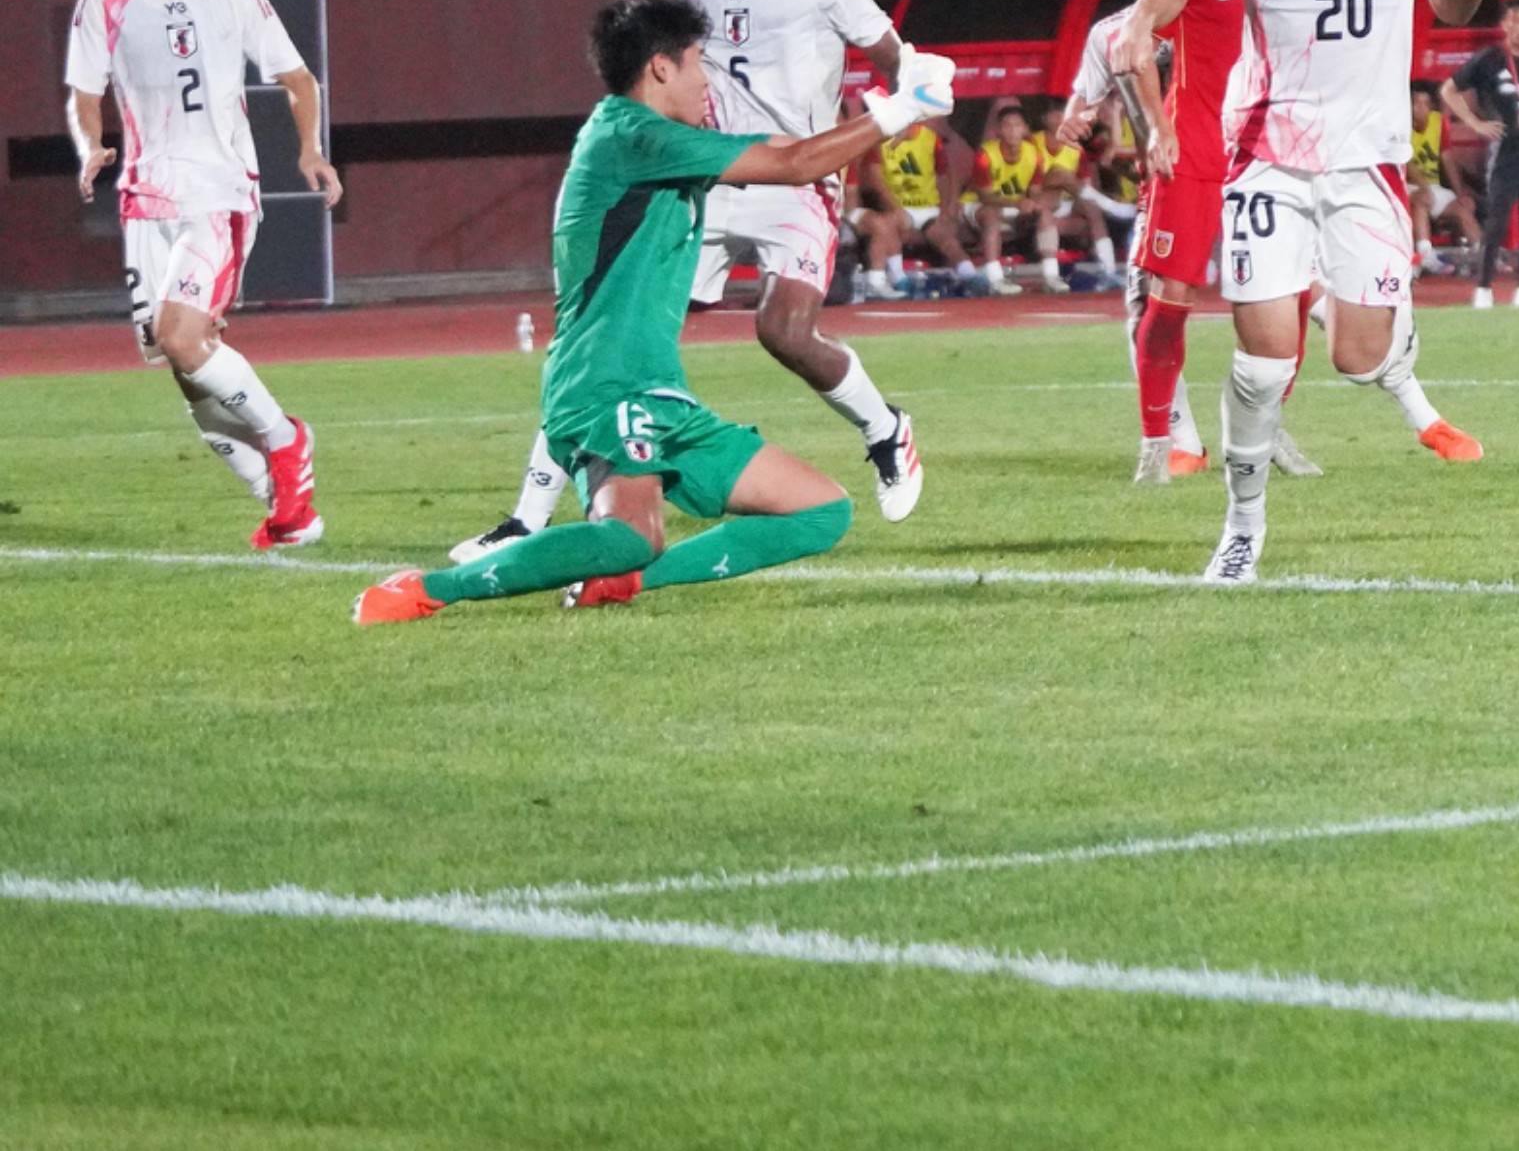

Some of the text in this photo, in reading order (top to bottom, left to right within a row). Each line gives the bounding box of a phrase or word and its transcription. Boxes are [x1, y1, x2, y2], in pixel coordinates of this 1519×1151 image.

[177, 67, 203, 113] 2
[1226, 192, 1276, 241] 20
[1375, 277, 1400, 293] Y-3
[617, 400, 655, 438] 12
